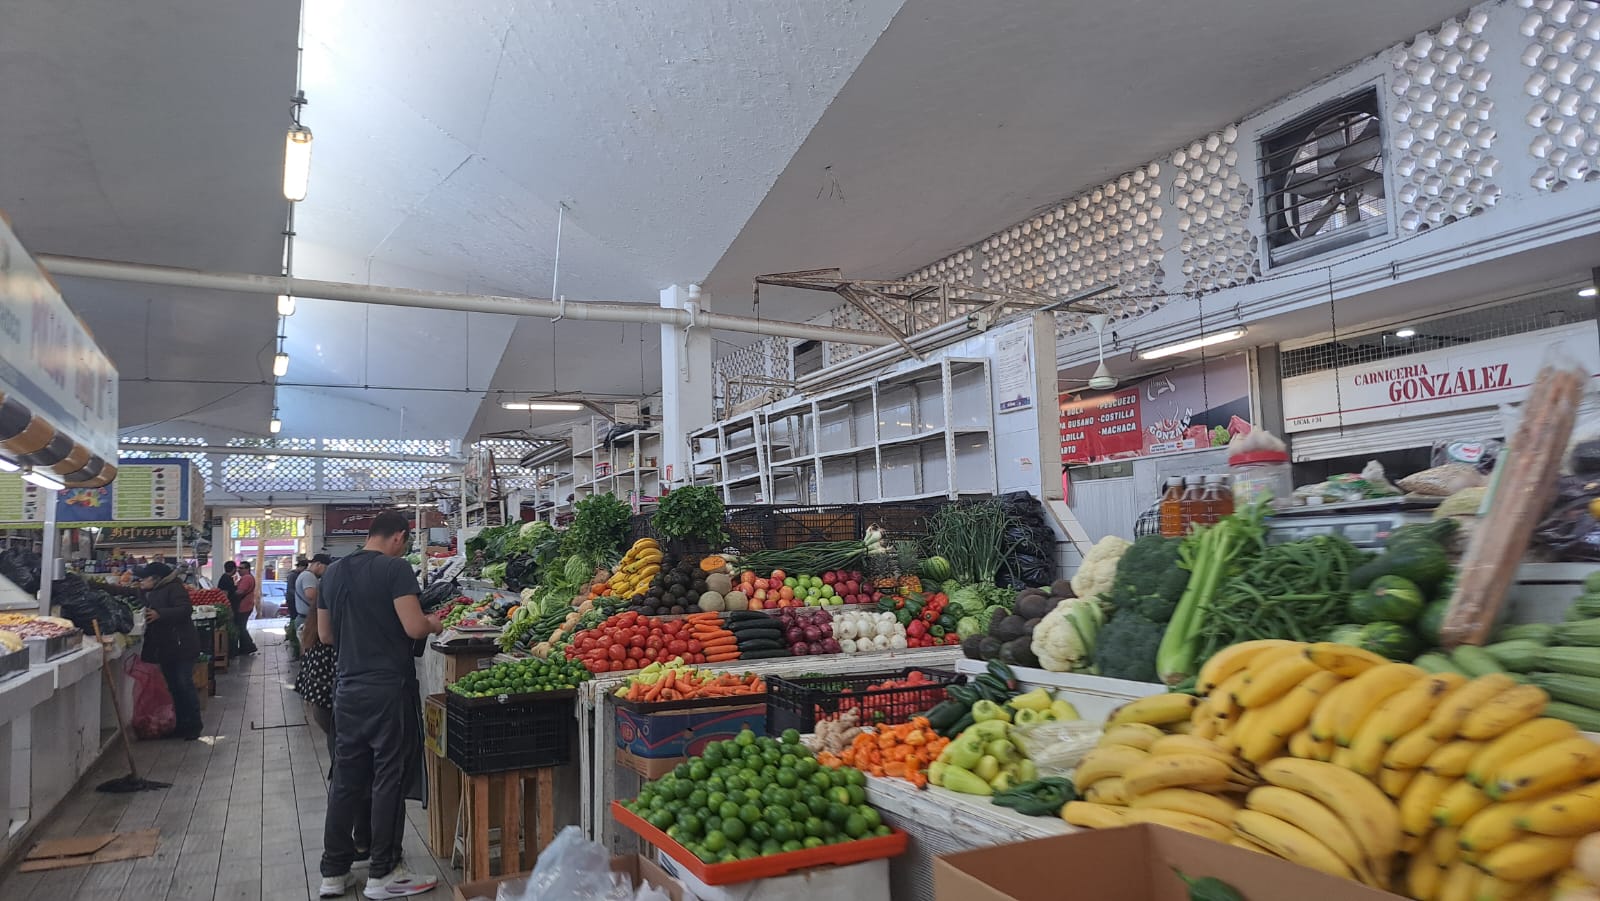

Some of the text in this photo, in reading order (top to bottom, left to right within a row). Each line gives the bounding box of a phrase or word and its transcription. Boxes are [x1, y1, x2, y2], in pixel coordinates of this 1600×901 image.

[1354, 364, 1428, 386] CARNICERIA
[1389, 363, 1511, 402] GONZÁLEZ
[1067, 417, 1094, 429] GUSANO
[1100, 409, 1135, 423] COSTILLA
[1101, 423, 1136, 436] MACHACA
